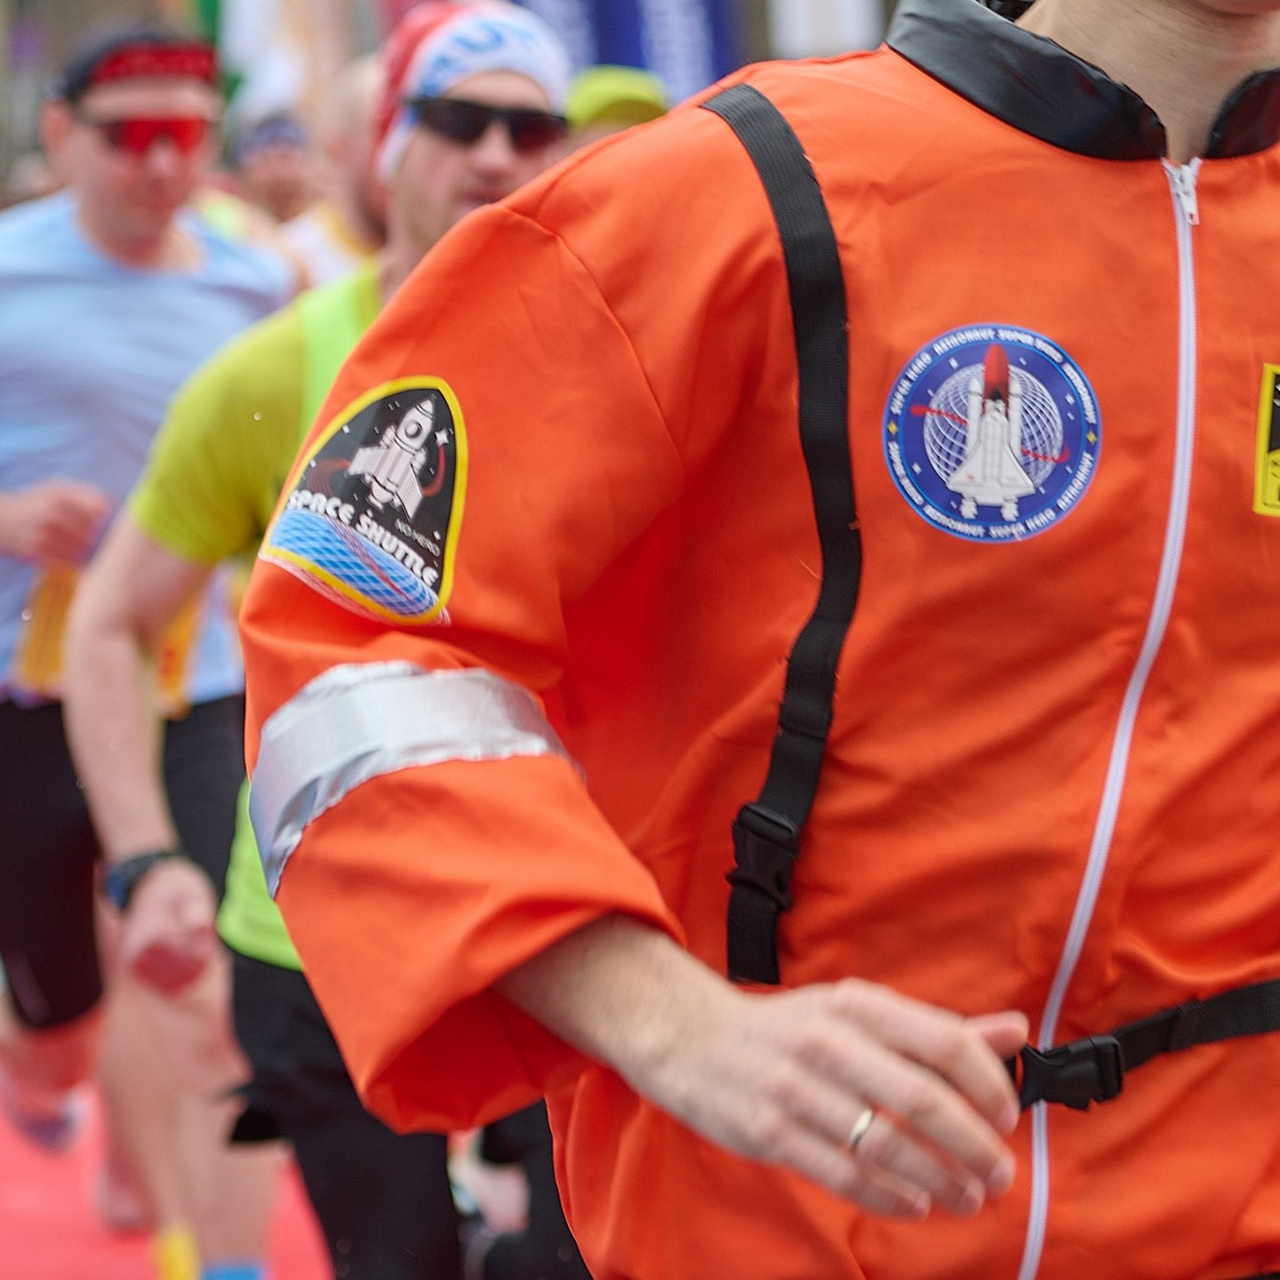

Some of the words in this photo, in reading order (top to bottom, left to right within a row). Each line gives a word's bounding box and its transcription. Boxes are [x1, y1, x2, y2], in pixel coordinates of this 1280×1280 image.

[286, 490, 356, 526] SPACE
[355, 514, 440, 588] SHUTTLE
[394, 517, 413, 538] NO
[410, 530, 442, 558] HERO
